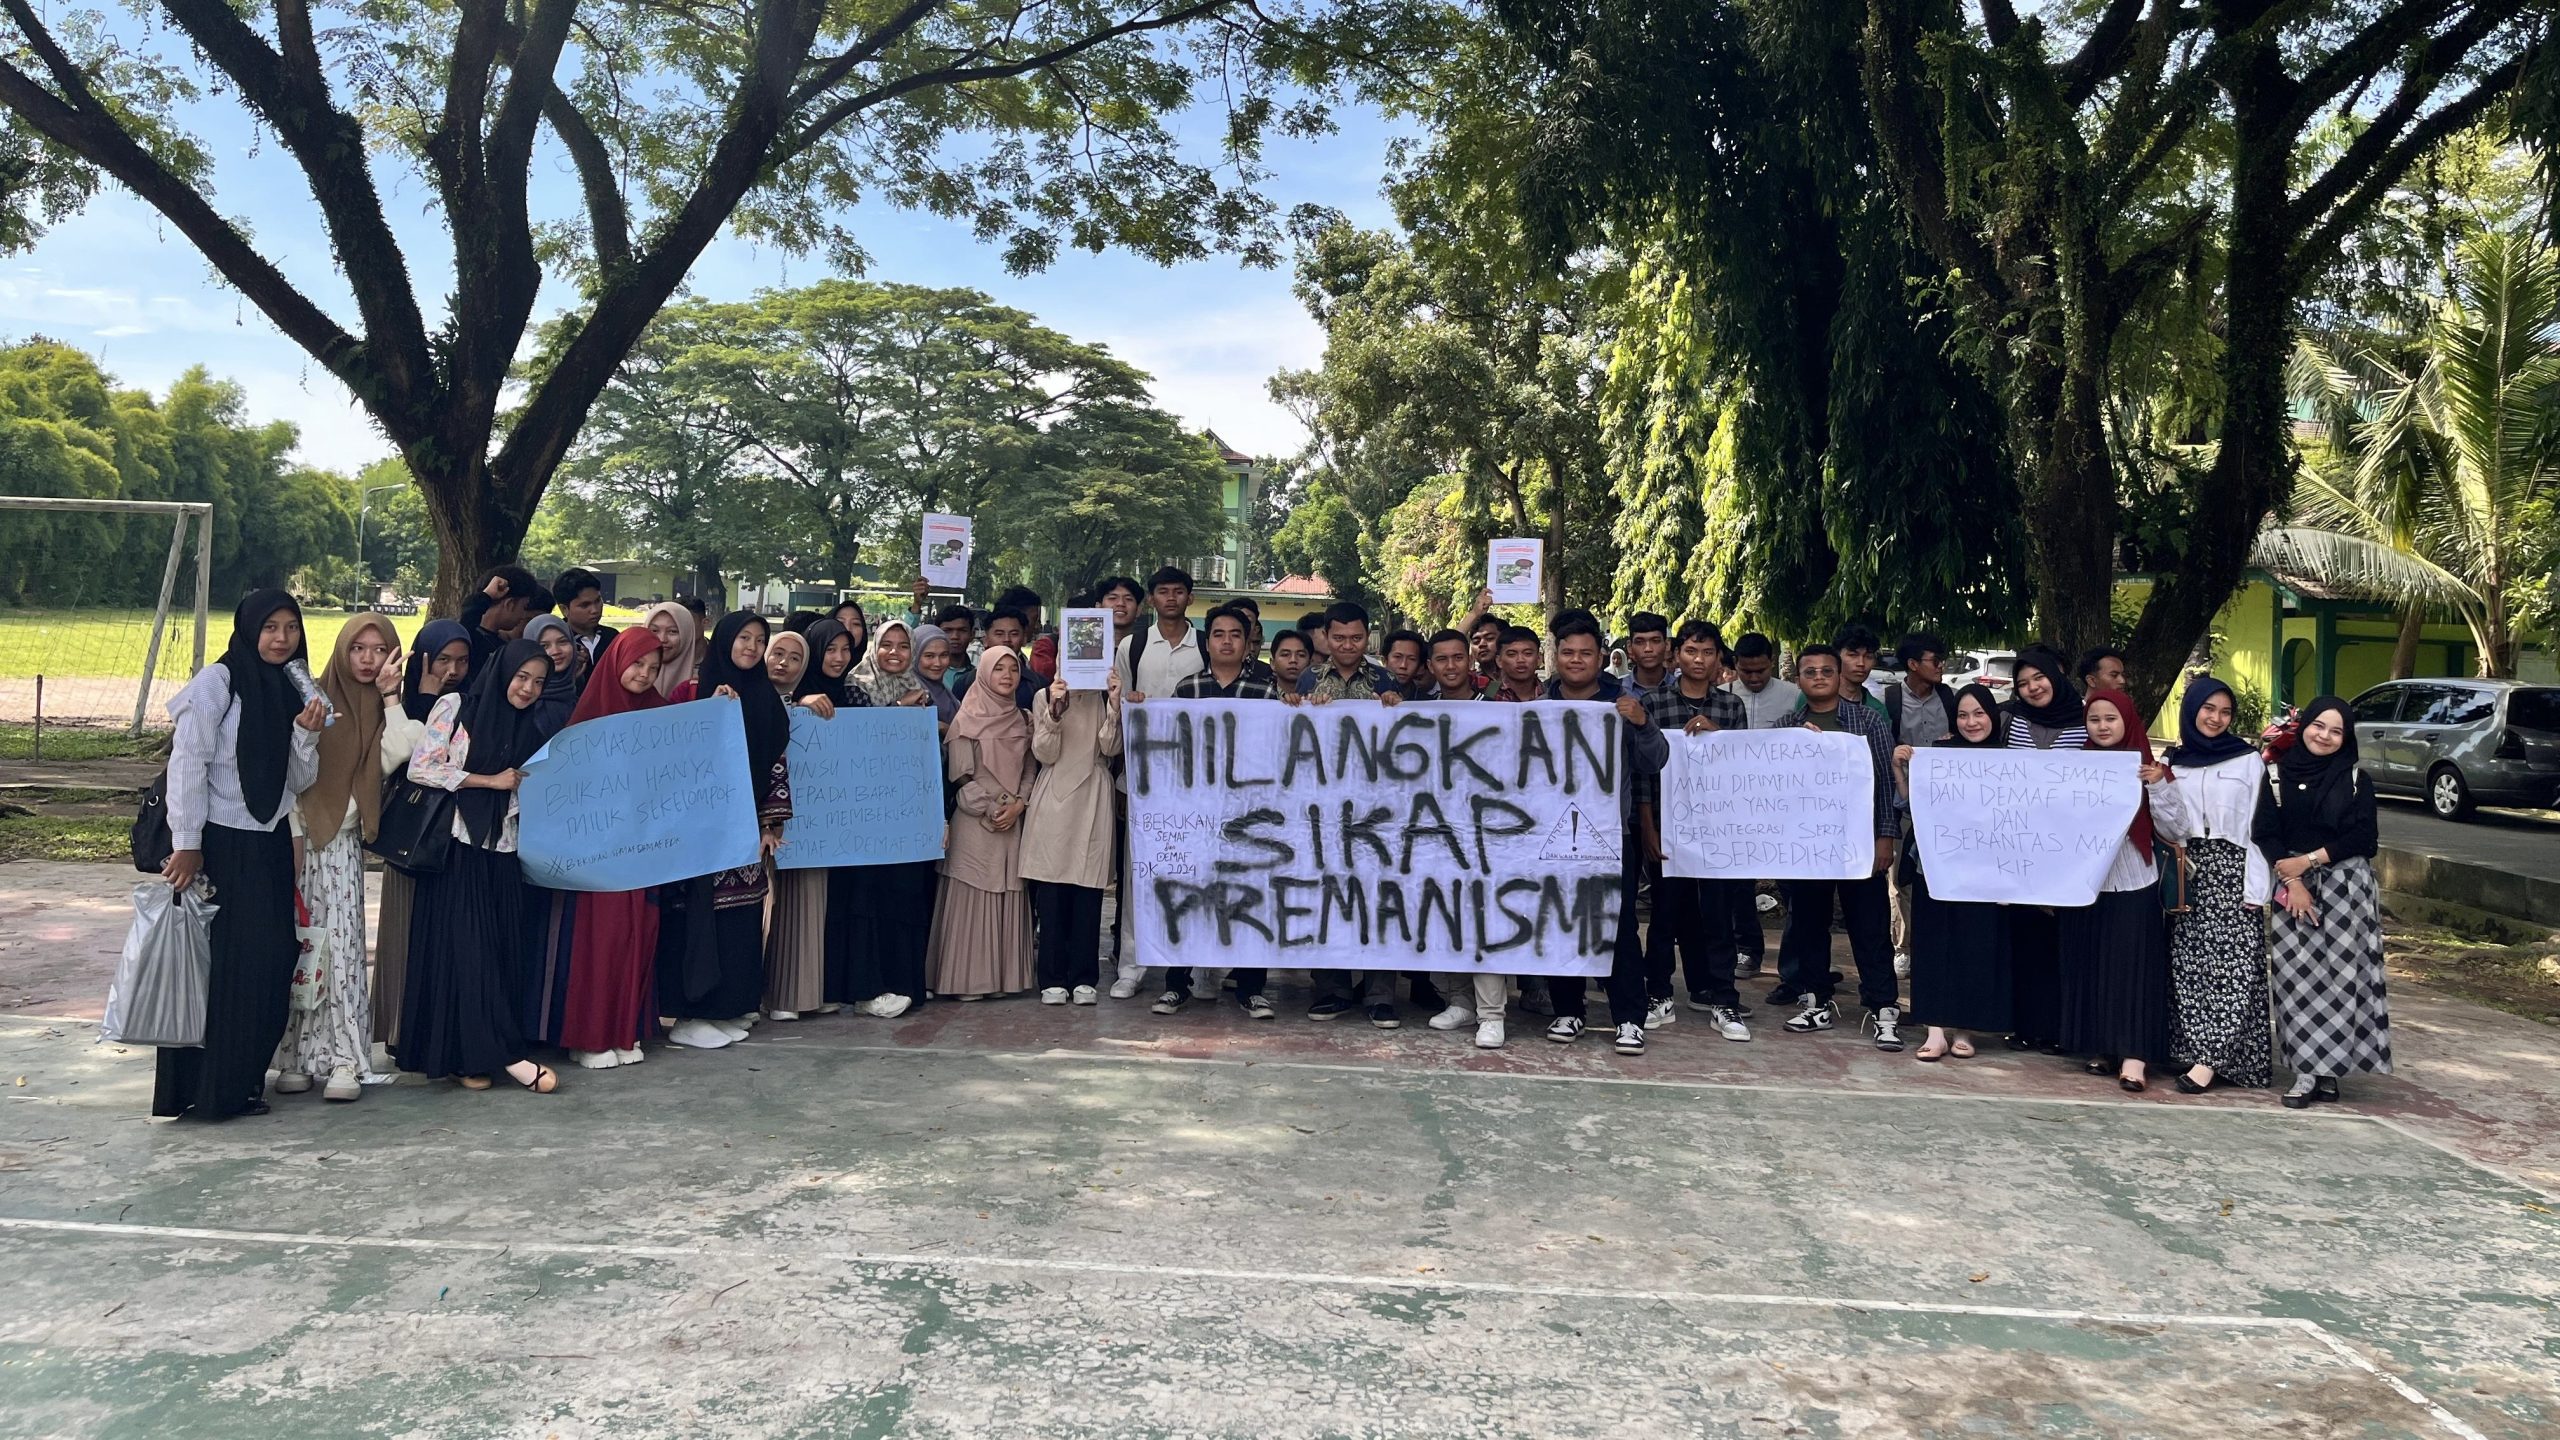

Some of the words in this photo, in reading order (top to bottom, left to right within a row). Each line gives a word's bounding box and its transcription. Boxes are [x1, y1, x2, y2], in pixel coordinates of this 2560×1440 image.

[554, 732, 627, 774] SEMAF
[1128, 708, 1617, 796] HILANGKAN
[1684, 743, 1736, 768] KAMI
[1744, 742, 1827, 765] MERASA
[1673, 775, 1721, 795] MALU
[1732, 773, 1805, 796] DIPIMPIN
[1815, 771, 1849, 786] OLEH
[1930, 759, 2028, 781] BEKUKAN
[2043, 762, 2119, 790] SEMAF
[544, 773, 631, 817] BUKAN
[645, 759, 717, 792] HANYA
[794, 785, 848, 806] EPADA
[1929, 781, 1966, 807] DAN
[1980, 786, 2058, 807] DEMAF
[2073, 790, 2113, 807] FDK
[566, 809, 625, 839] MILIK
[635, 786, 736, 824] SEKELOMPOK
[1129, 811, 1215, 832] #BEKUKAN
[1672, 800, 1736, 821] OKNUM
[1742, 797, 1789, 817] YANG
[1799, 796, 1848, 812] TIDAK
[1992, 807, 2028, 832] DAN
[1155, 831, 1190, 843] SEMAF
[1212, 792, 1537, 876] SIKAP
[1674, 824, 1785, 845] BERINTEGRASI
[1799, 822, 1848, 839] SERTA
[1934, 824, 2064, 856] BERANTAS
[1156, 852, 1192, 863] DEMAF
[1701, 841, 1859, 870] BERDEDIKASI
[1997, 857, 2035, 877] KIP
[1131, 862, 1159, 879] FDK
[1167, 863, 1197, 877] 2024
[1153, 874, 1621, 962] PREMANISME
